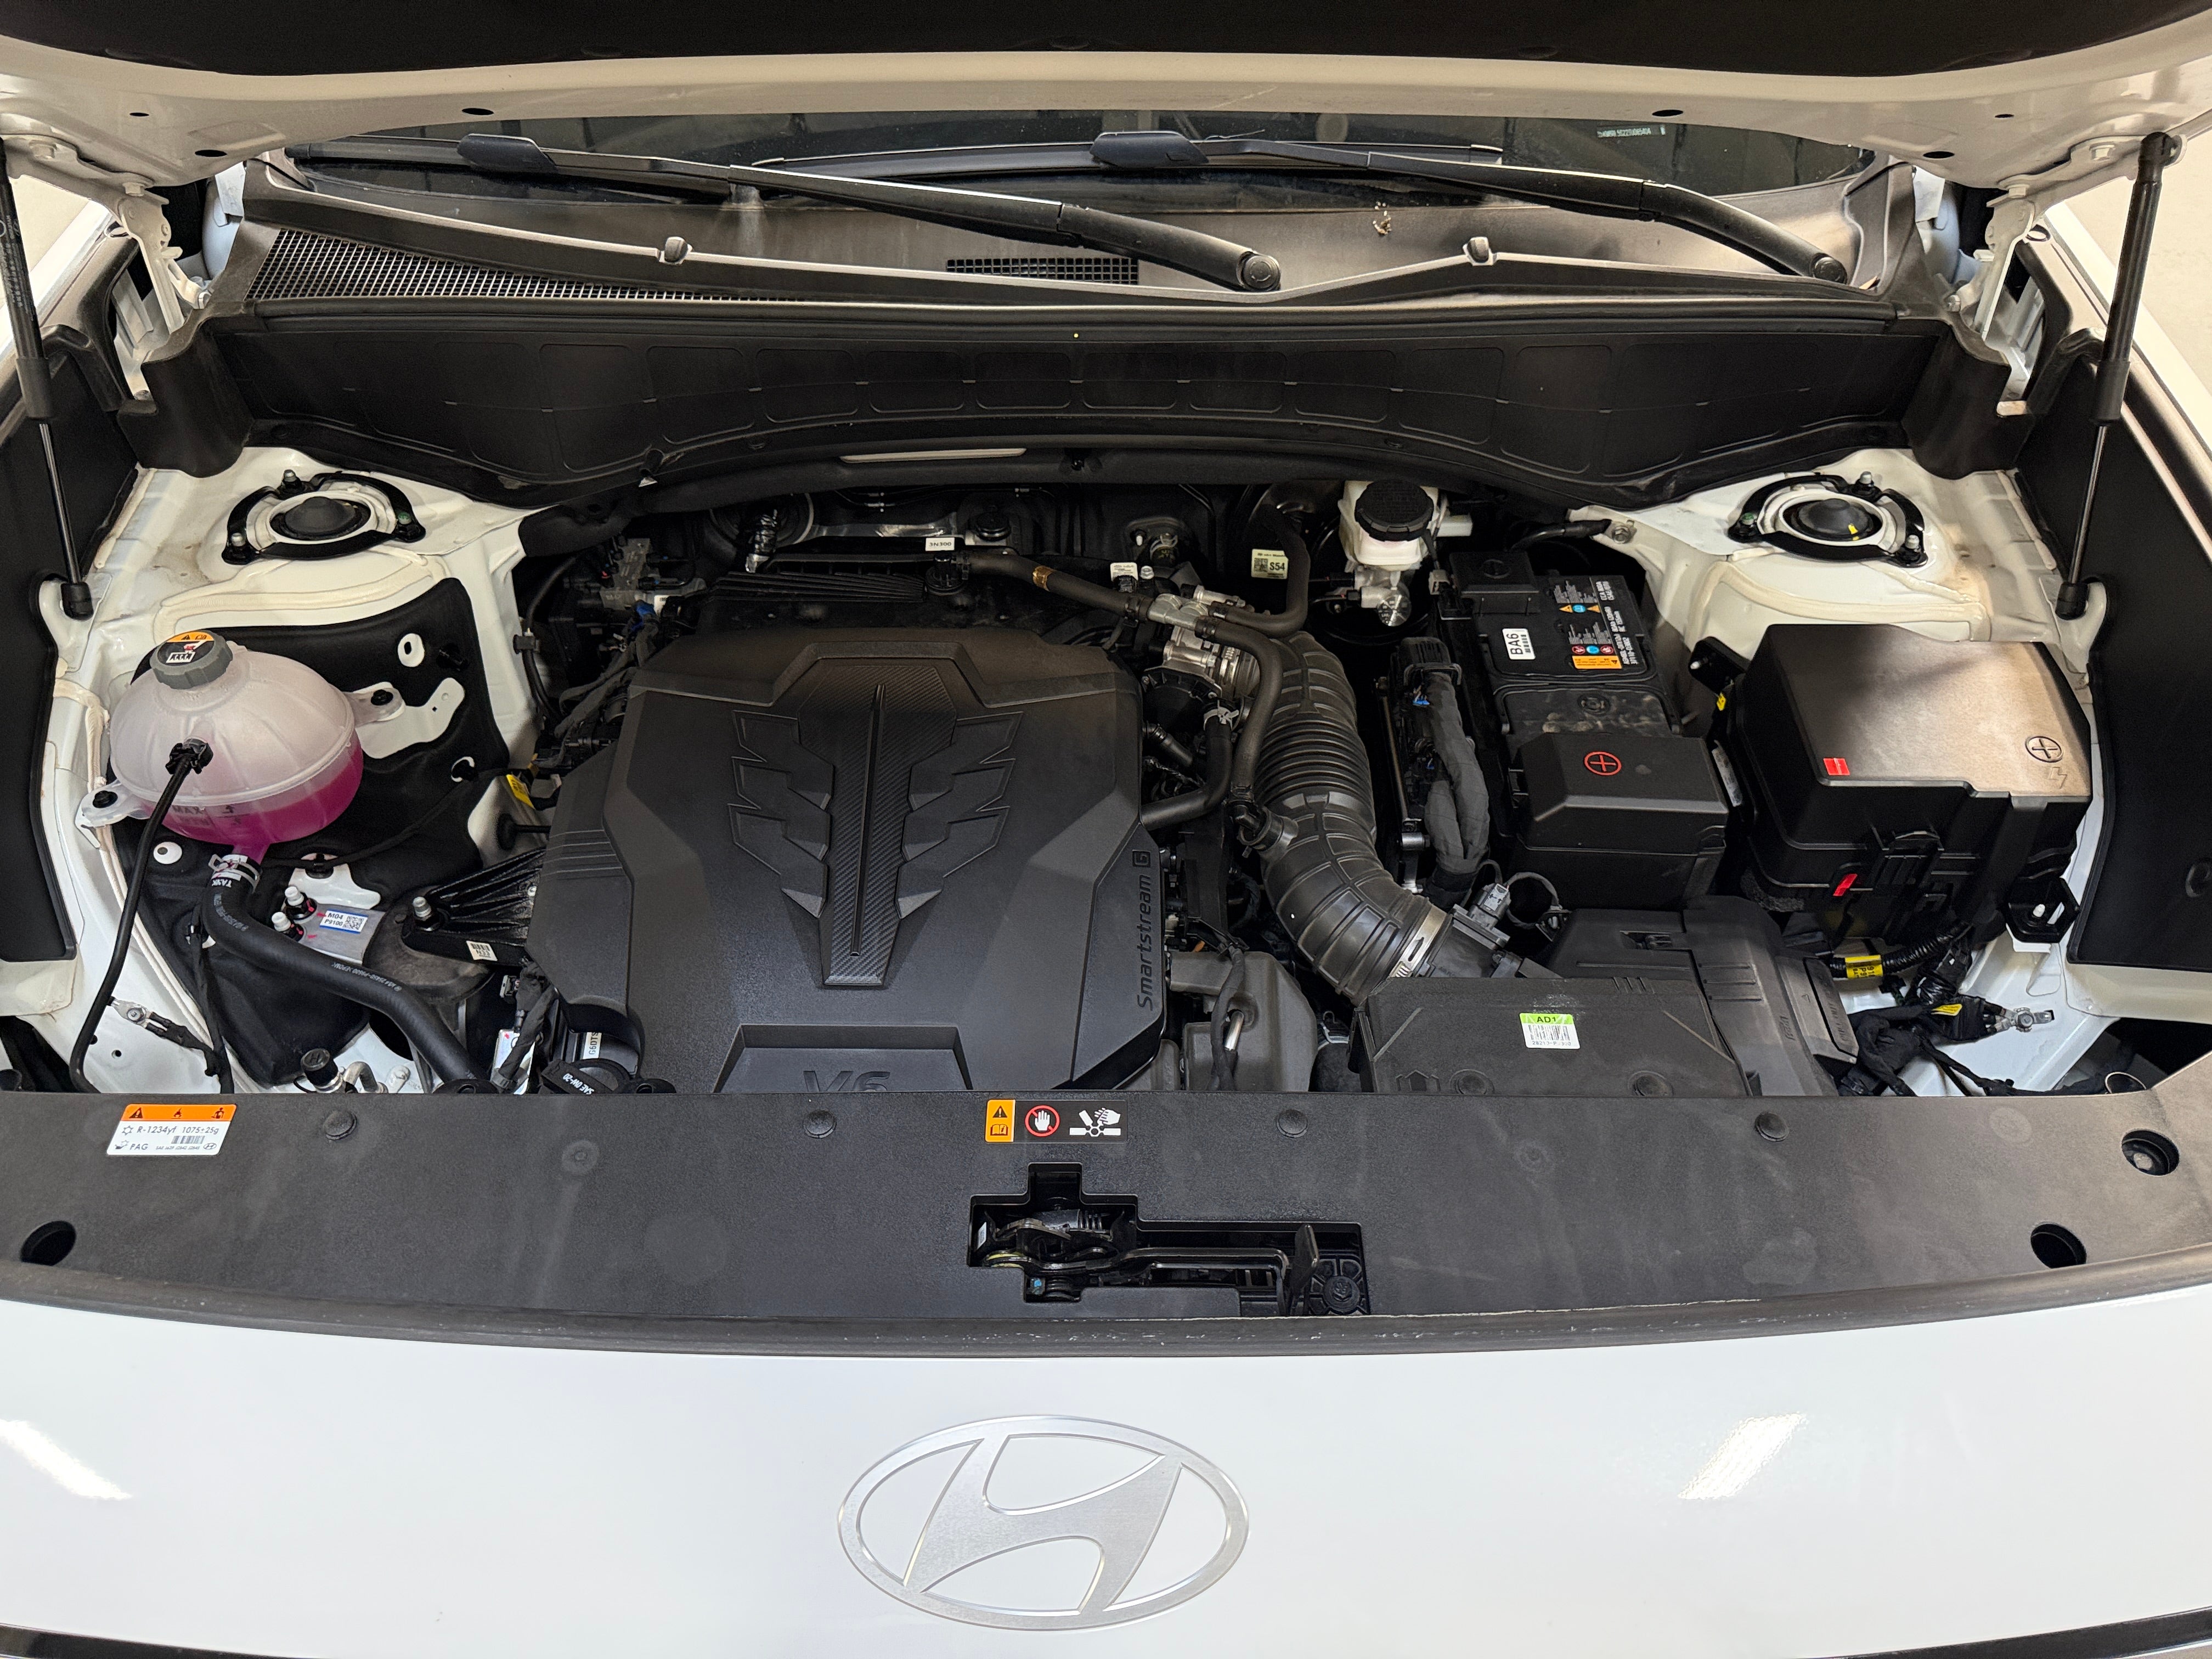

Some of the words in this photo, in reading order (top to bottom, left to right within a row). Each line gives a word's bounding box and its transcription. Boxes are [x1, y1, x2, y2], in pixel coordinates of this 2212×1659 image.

[1269, 562, 1285, 571] S54
[1506, 633, 1523, 654] BA6
[172, 805, 203, 814] MAX
[212, 879, 232, 888] TANK
[1137, 874, 1153, 1012] Smartstream
[589, 1032, 599, 1054] G6DTS
[562, 1073, 583, 1088] 0W-20
[803, 1071, 890, 1091] V6
[579, 1084, 595, 1095] SAE
[137, 1126, 177, 1135] R-1234yf
[182, 1126, 219, 1135] 1075±25g
